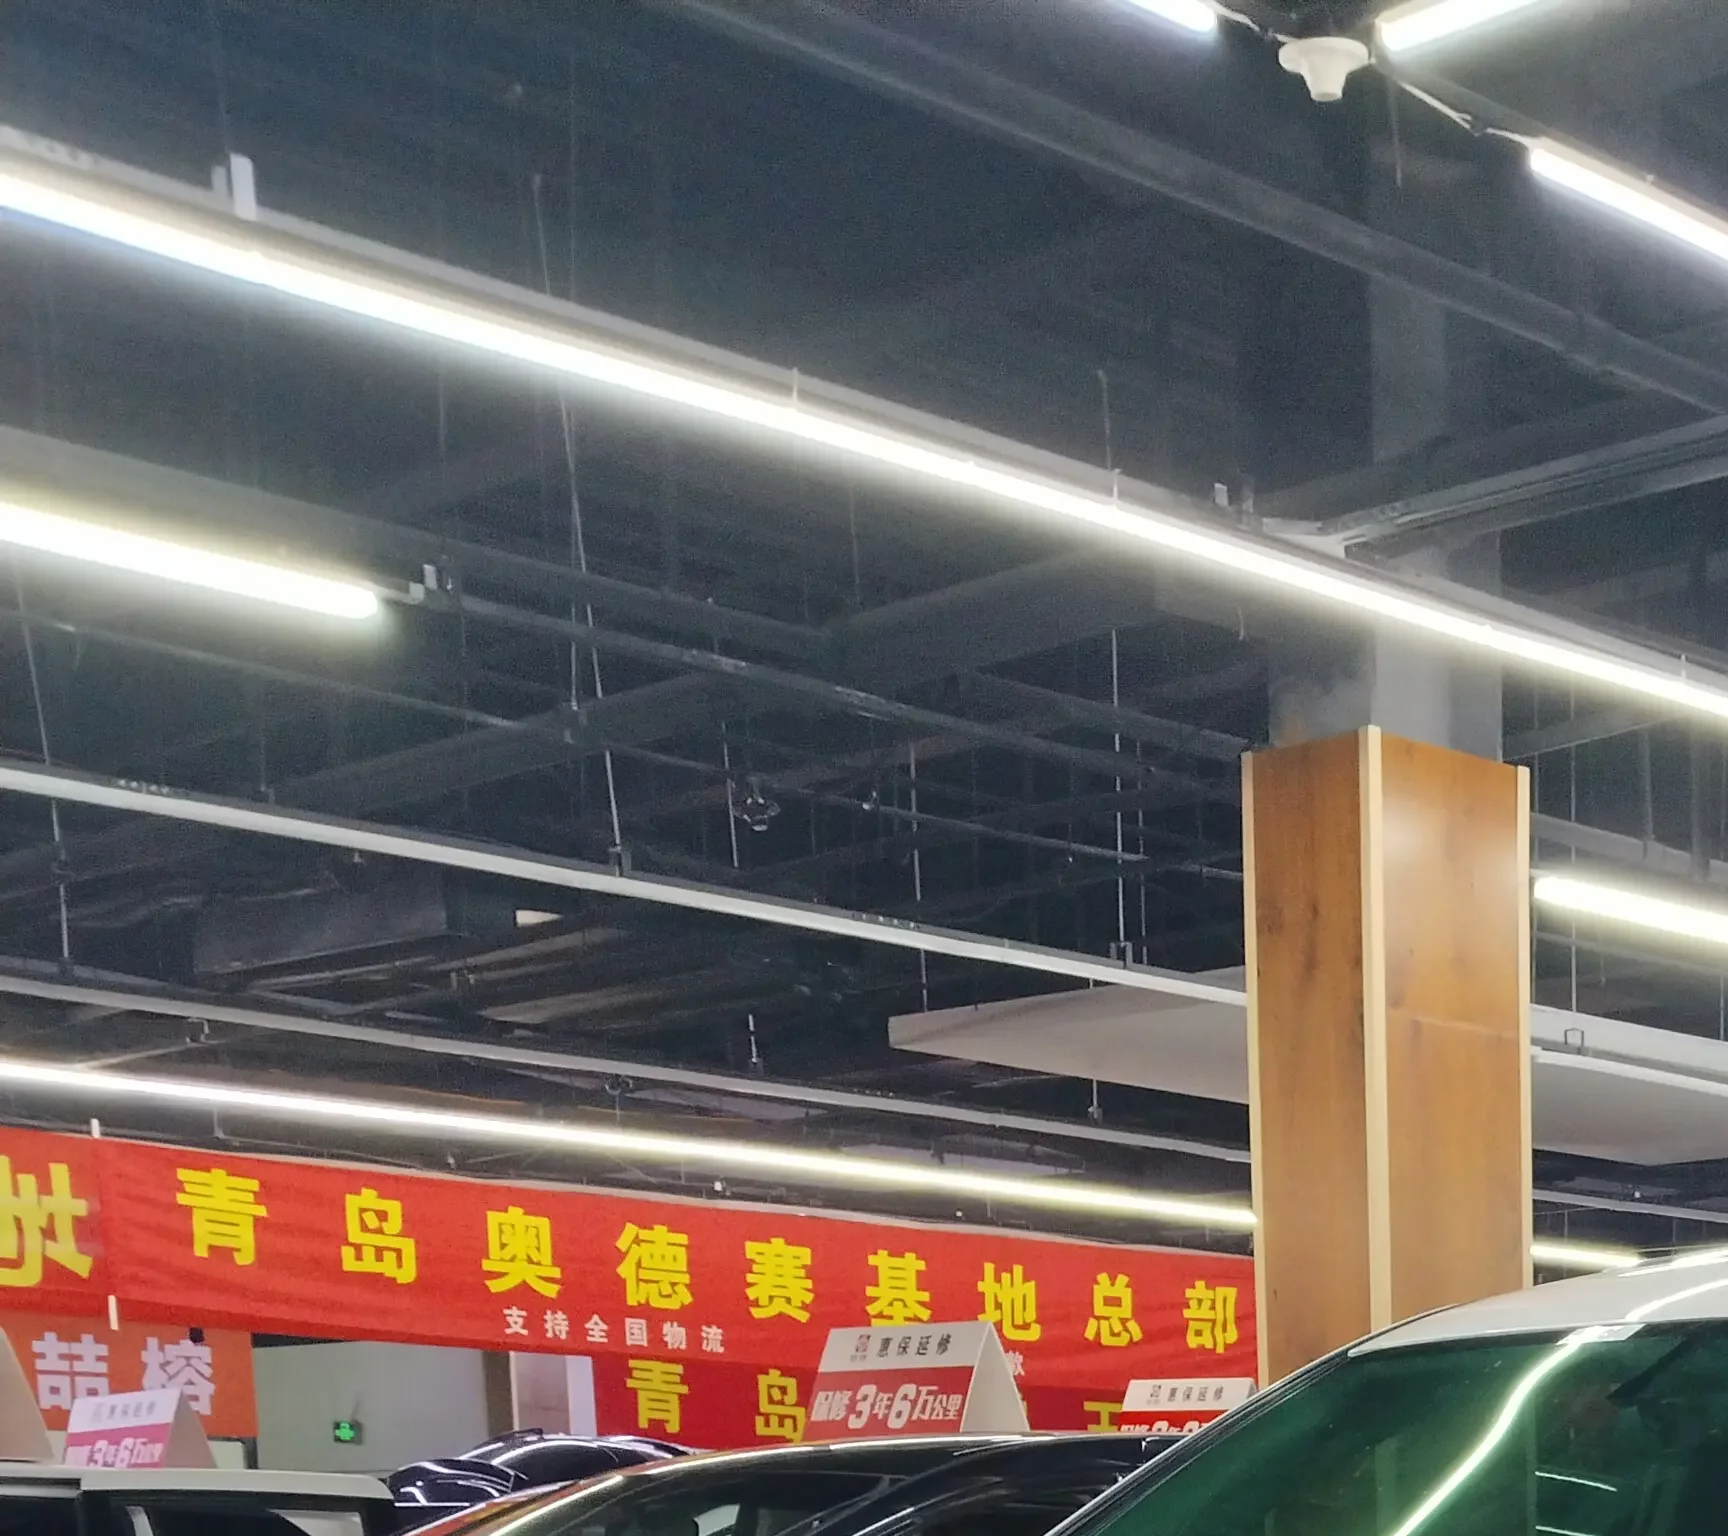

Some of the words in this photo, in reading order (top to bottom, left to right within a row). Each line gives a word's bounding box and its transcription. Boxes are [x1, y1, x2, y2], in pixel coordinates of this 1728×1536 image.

[176, 1167, 1239, 1353] 青岛奥德赛基地总部
[503, 1306, 725, 1353] 支持全国物流
[876, 1333, 953, 1358] 惠保延修
[626, 1359, 804, 1445] 青岛
[810, 1383, 964, 1430] 保修3年6万公里
